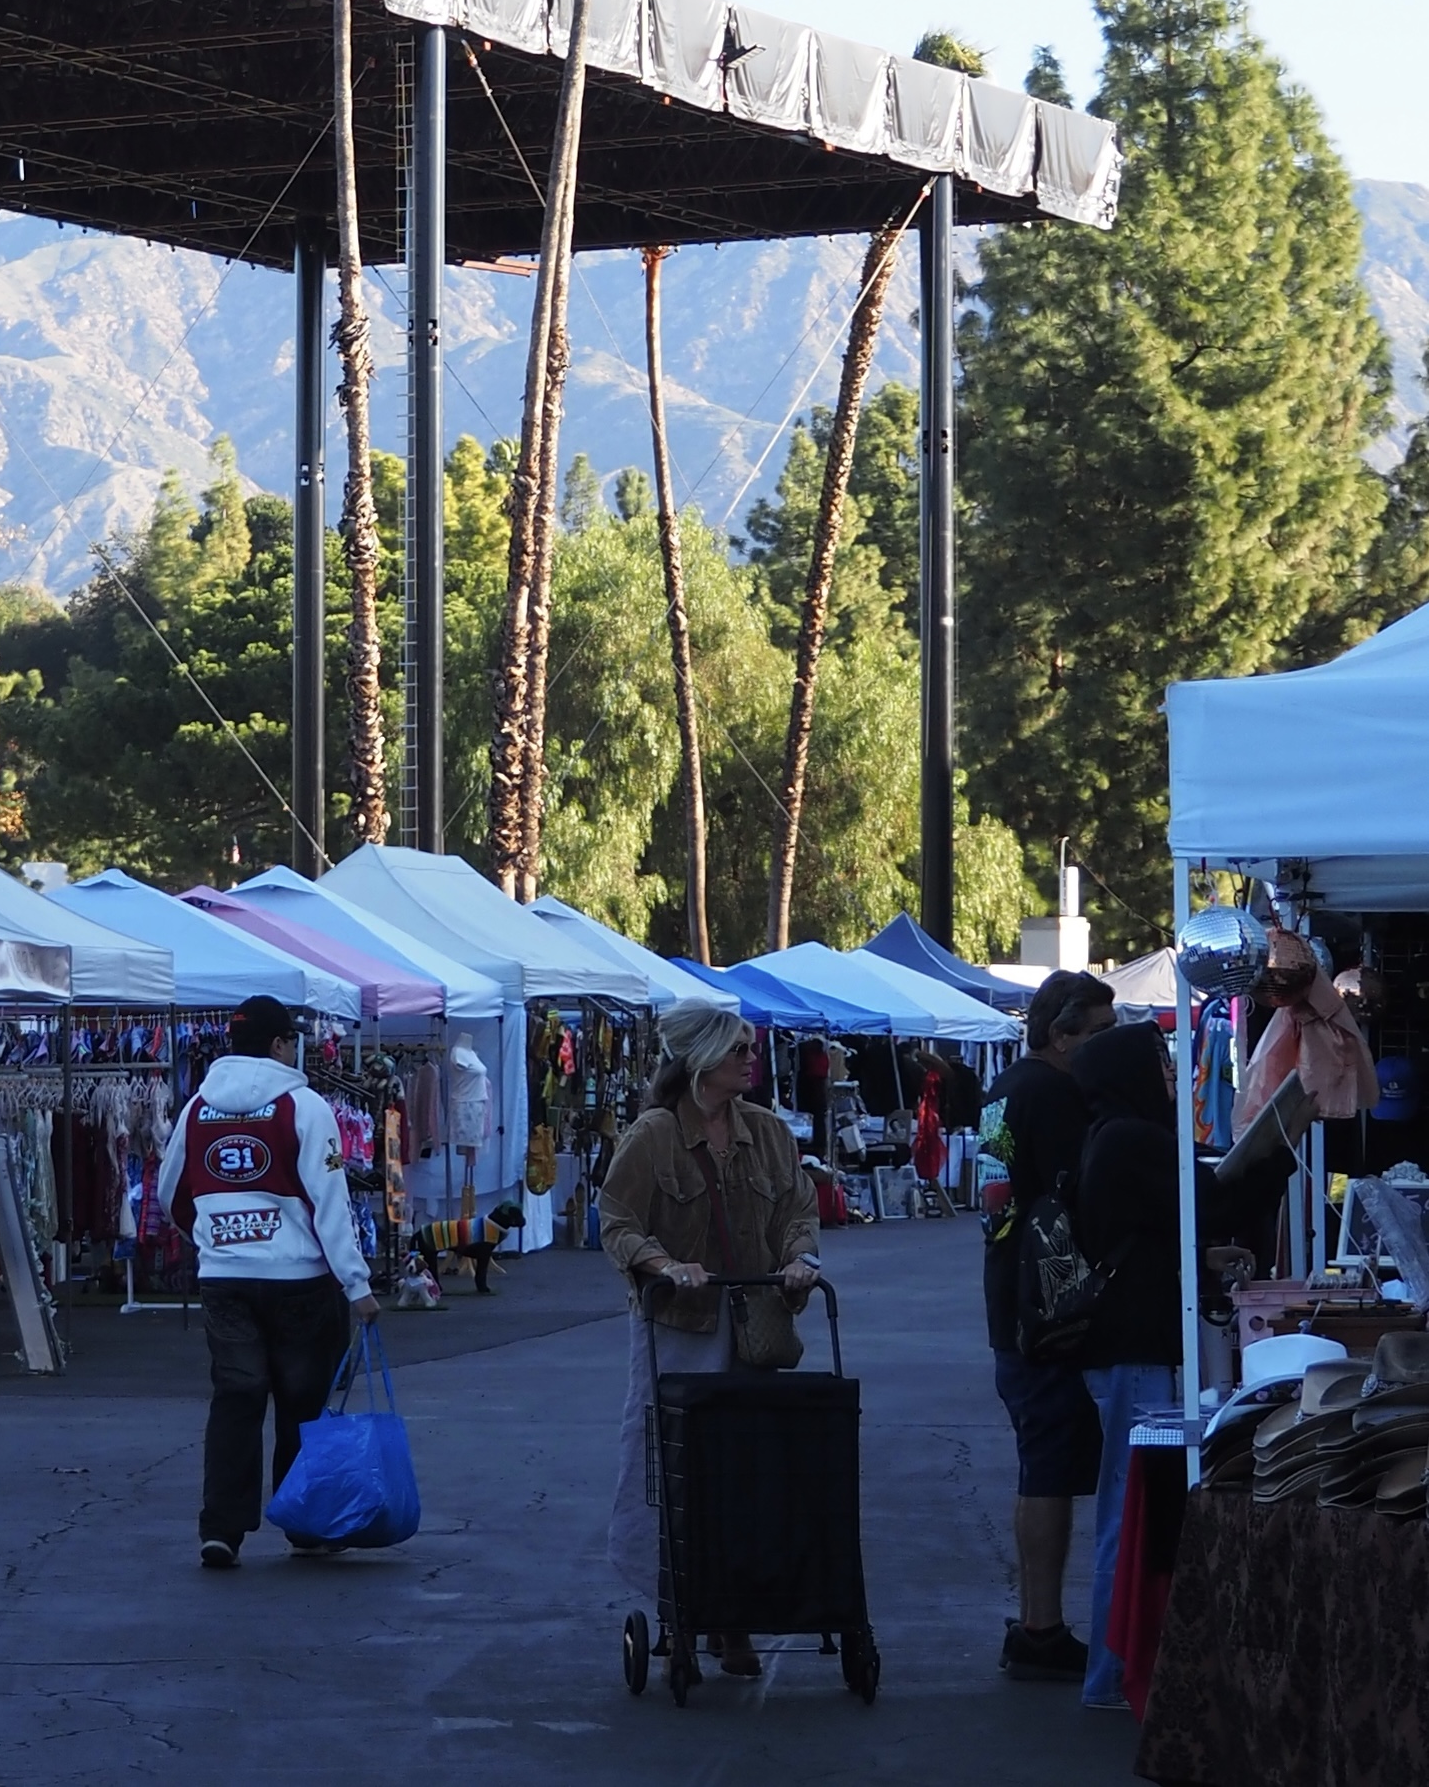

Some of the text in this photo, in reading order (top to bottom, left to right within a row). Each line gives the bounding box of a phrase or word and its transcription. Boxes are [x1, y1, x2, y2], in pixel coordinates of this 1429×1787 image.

[219, 1147, 255, 1169] 31
[215, 1221, 277, 1232] WORLD FAMOUS
